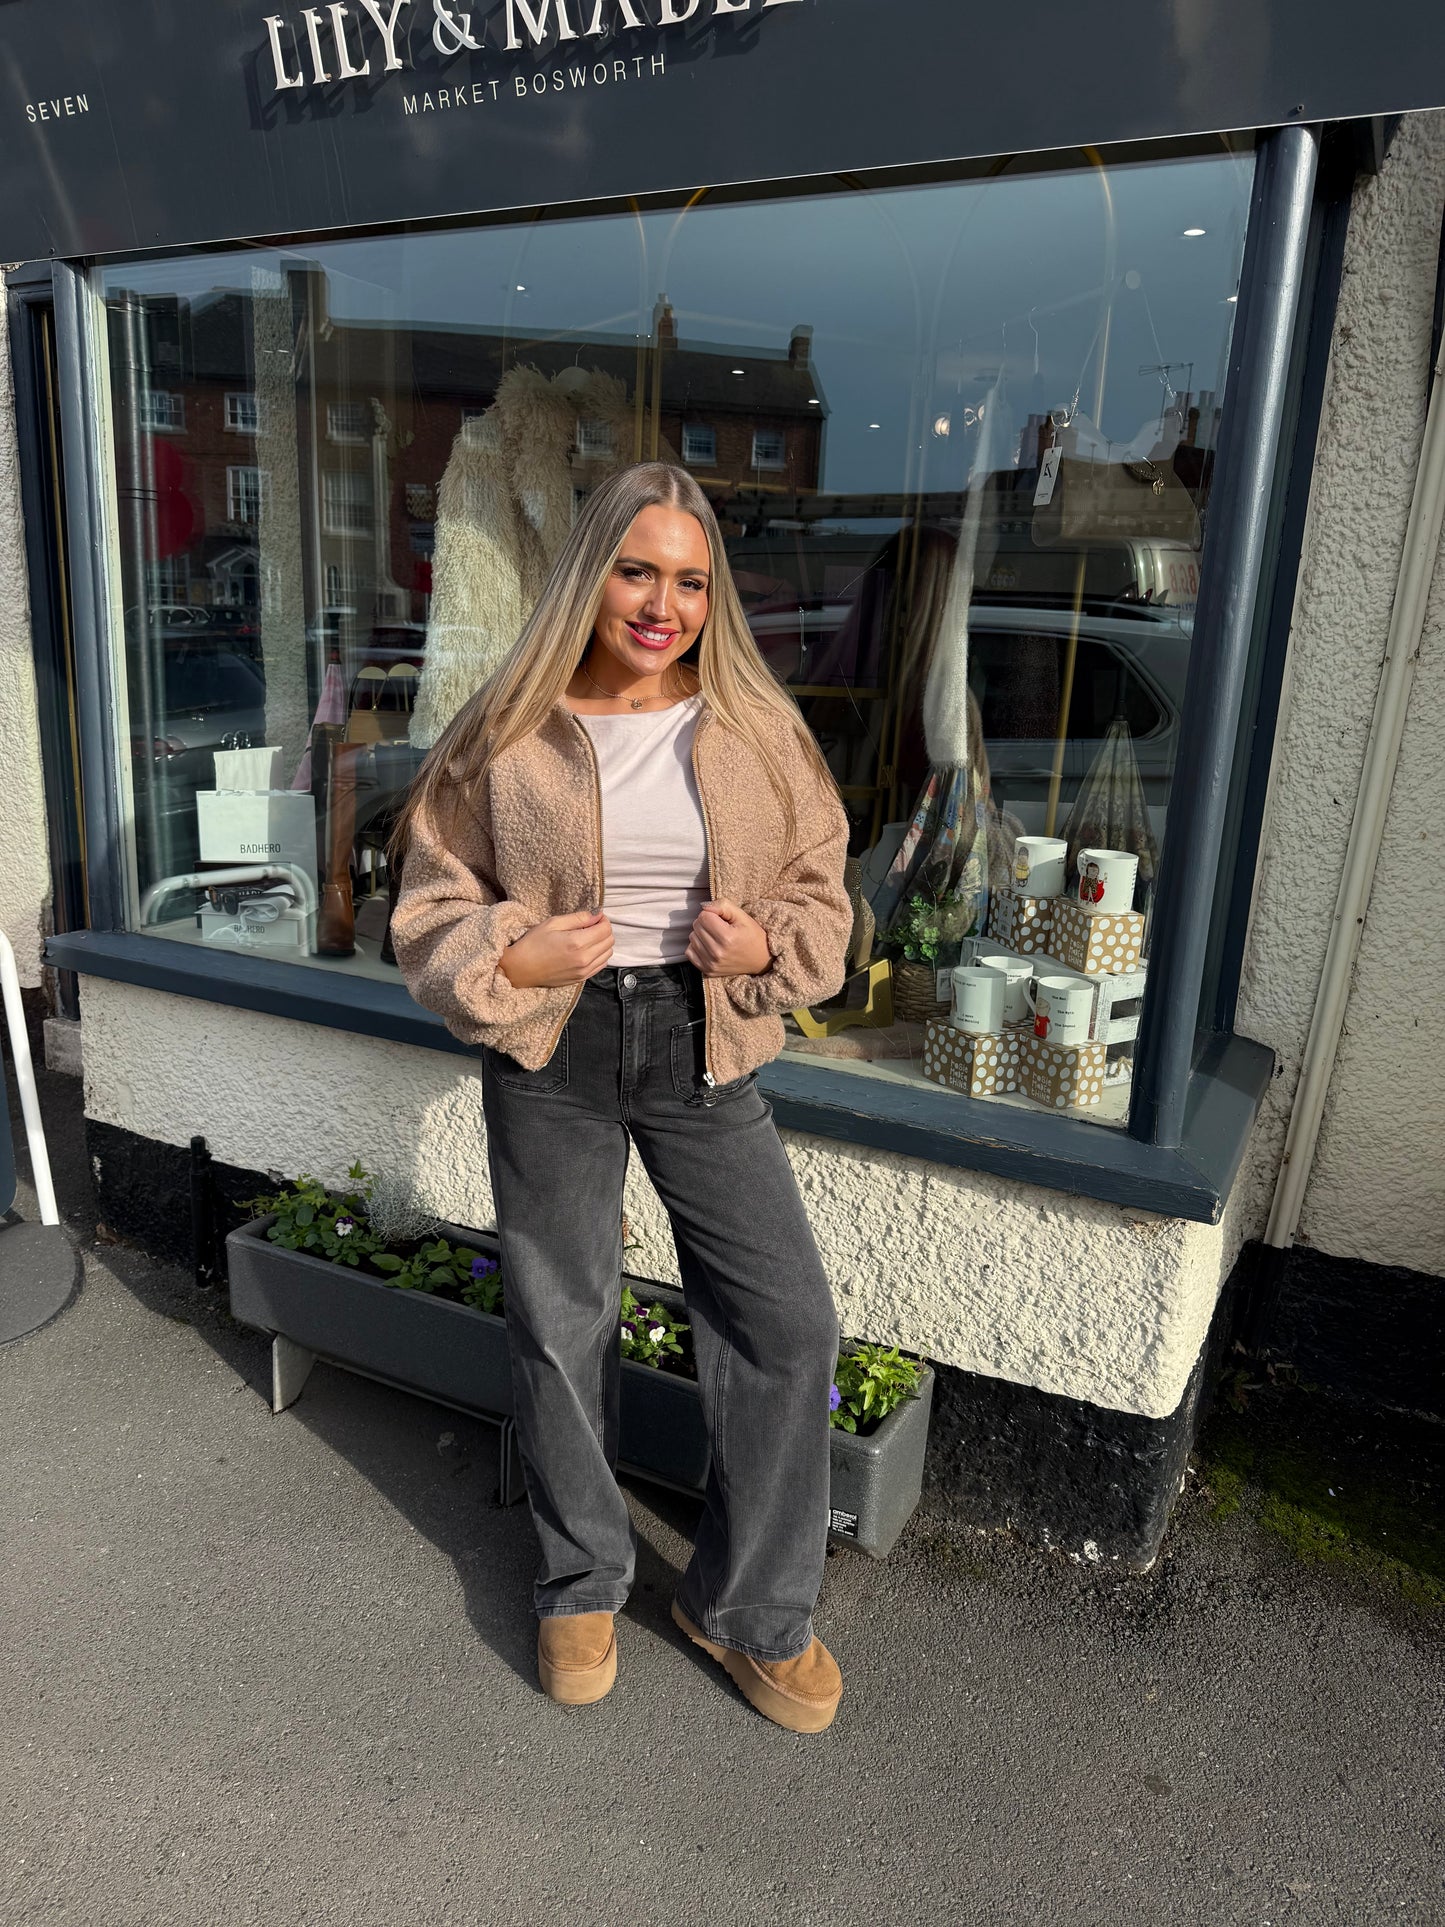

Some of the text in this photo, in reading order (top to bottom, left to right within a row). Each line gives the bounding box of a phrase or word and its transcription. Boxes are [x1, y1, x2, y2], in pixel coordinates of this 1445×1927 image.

[262, 0, 404, 90] LILY
[432, 0, 485, 55] &
[403, 53, 666, 115] MARKET BOSWORTH
[26, 94, 89, 123] SEVEN
[240, 843, 281, 854] BADHERO
[233, 924, 265, 933] BAHERO
